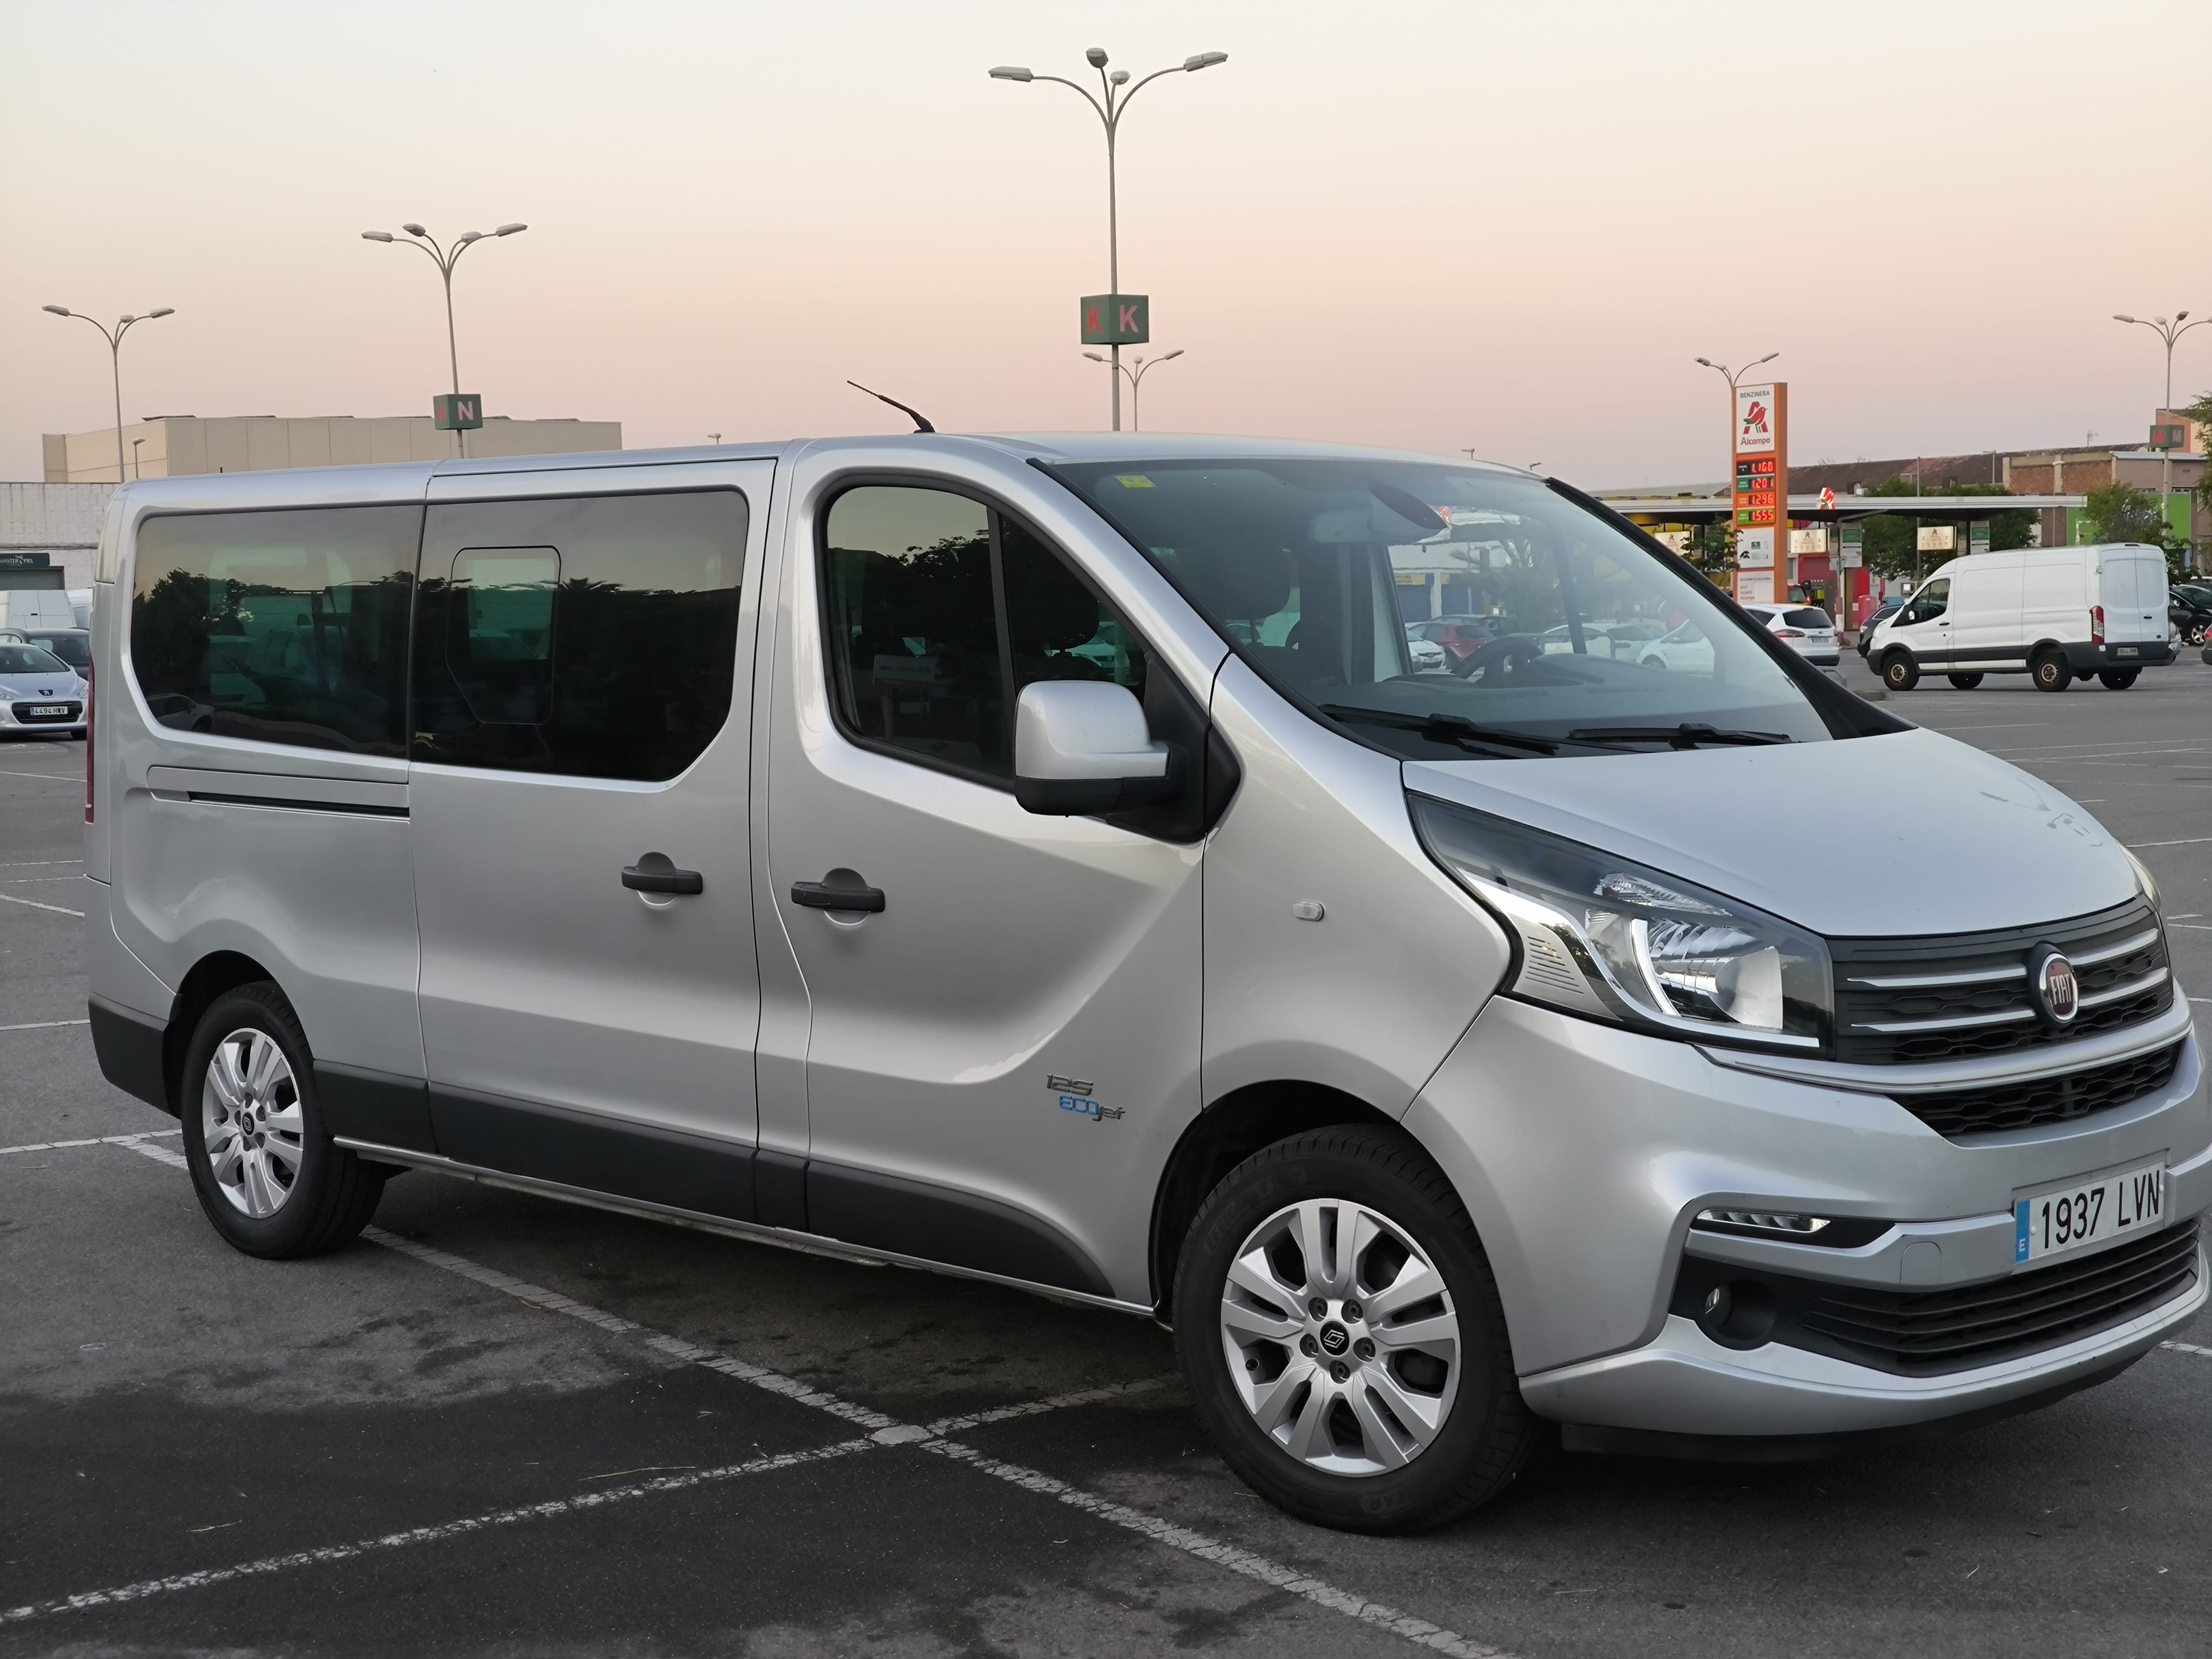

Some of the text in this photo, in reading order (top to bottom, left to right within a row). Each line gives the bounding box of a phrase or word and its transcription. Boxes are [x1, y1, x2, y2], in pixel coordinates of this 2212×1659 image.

[1087, 306, 1102, 335] K
[1120, 304, 1139, 333] K
[457, 401, 474, 421] N
[1741, 437, 1771, 446] Alcampo
[2154, 430, 2166, 443] M
[2173, 429, 2181, 443] M
[2049, 973, 2072, 1005] FIAT
[1047, 1074, 1093, 1096] 125
[2018, 1170, 2160, 1252] E 1937 LVN
